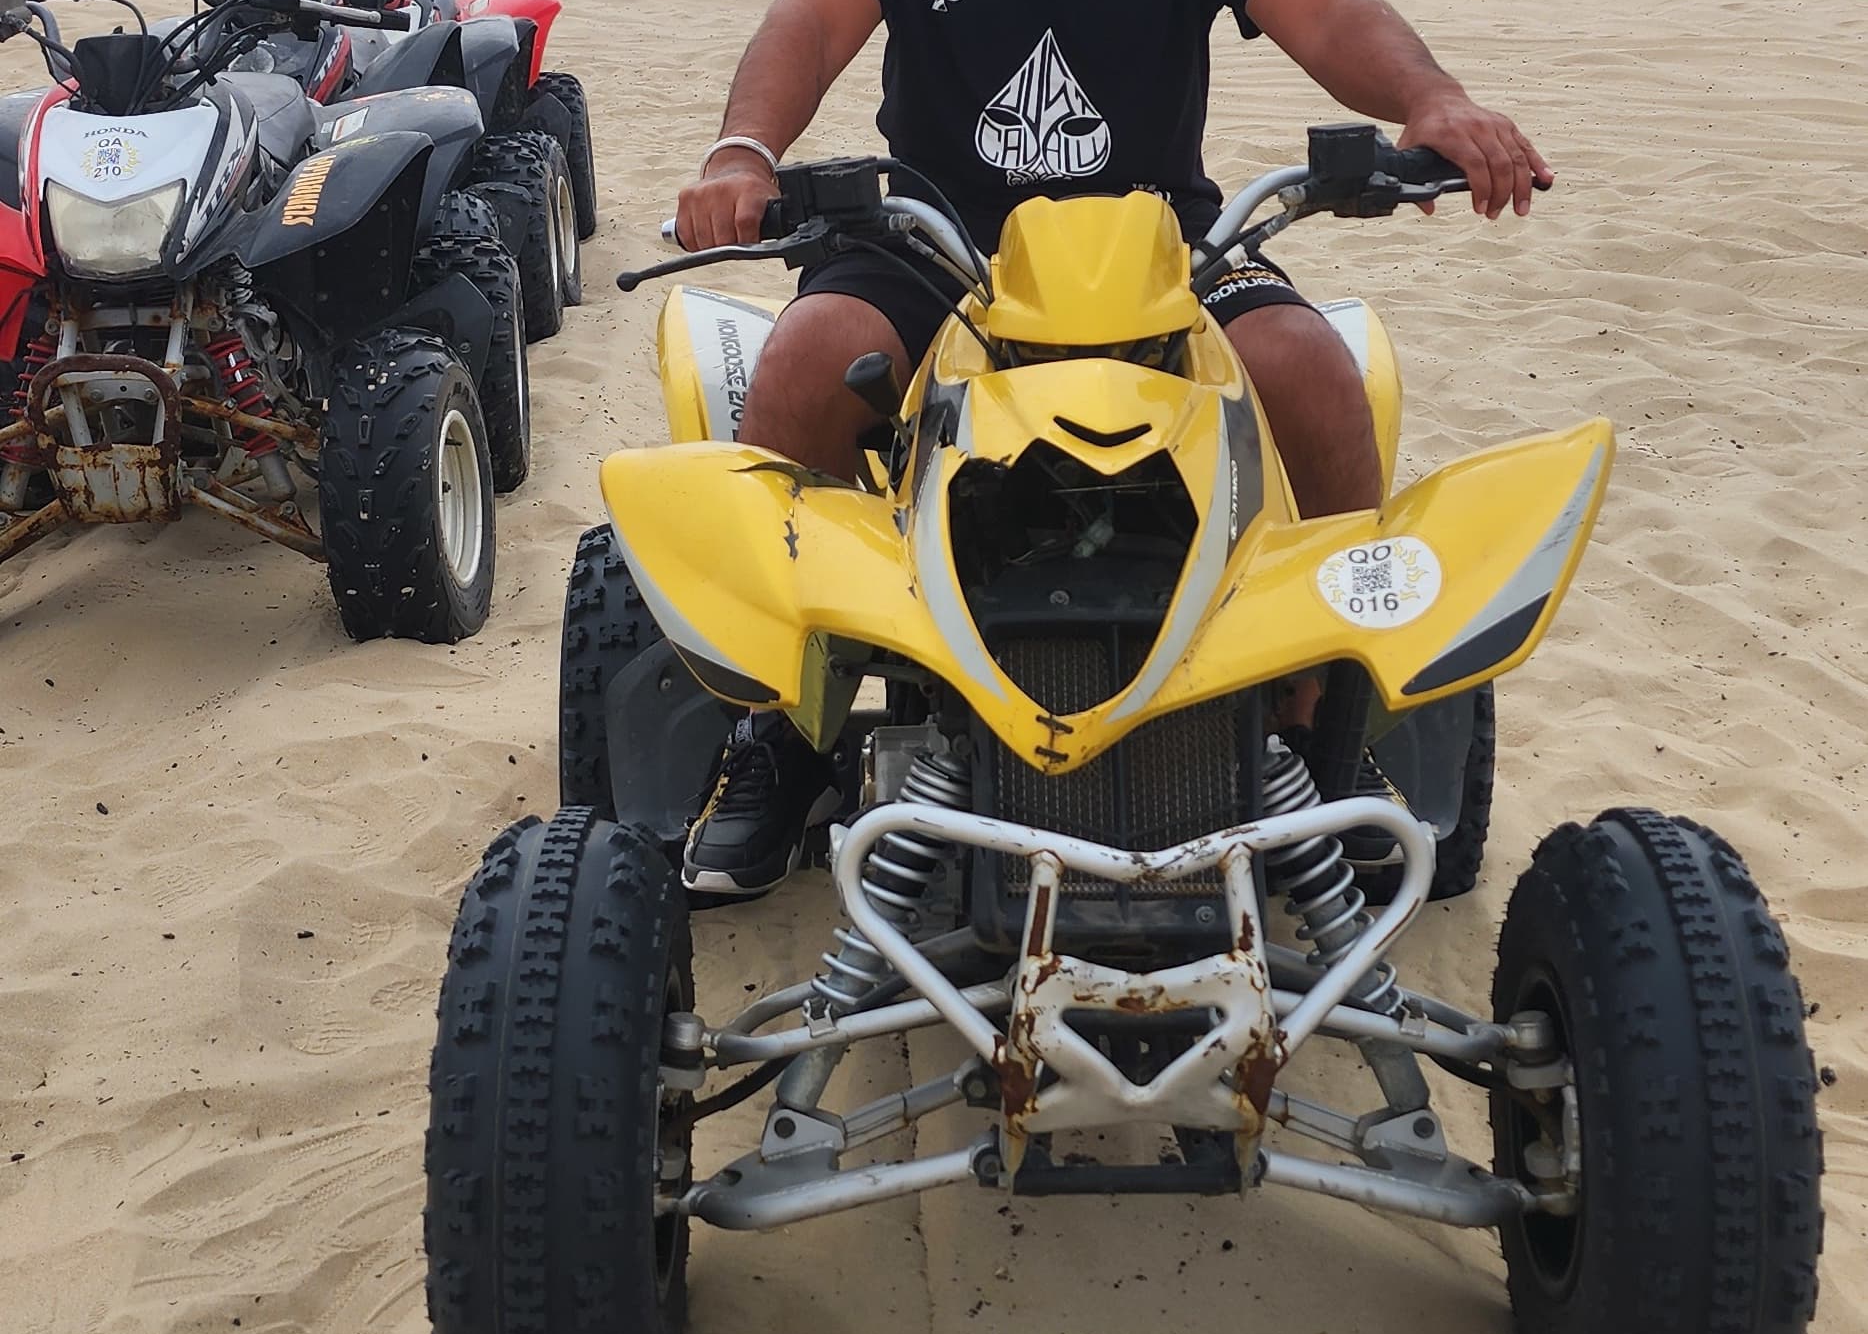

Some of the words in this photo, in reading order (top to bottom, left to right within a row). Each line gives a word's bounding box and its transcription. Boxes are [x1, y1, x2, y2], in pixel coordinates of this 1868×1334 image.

[83, 126, 149, 140] HONDA
[98, 137, 123, 148] QA
[93, 166, 122, 179] 210
[1349, 592, 1399, 614] 016
